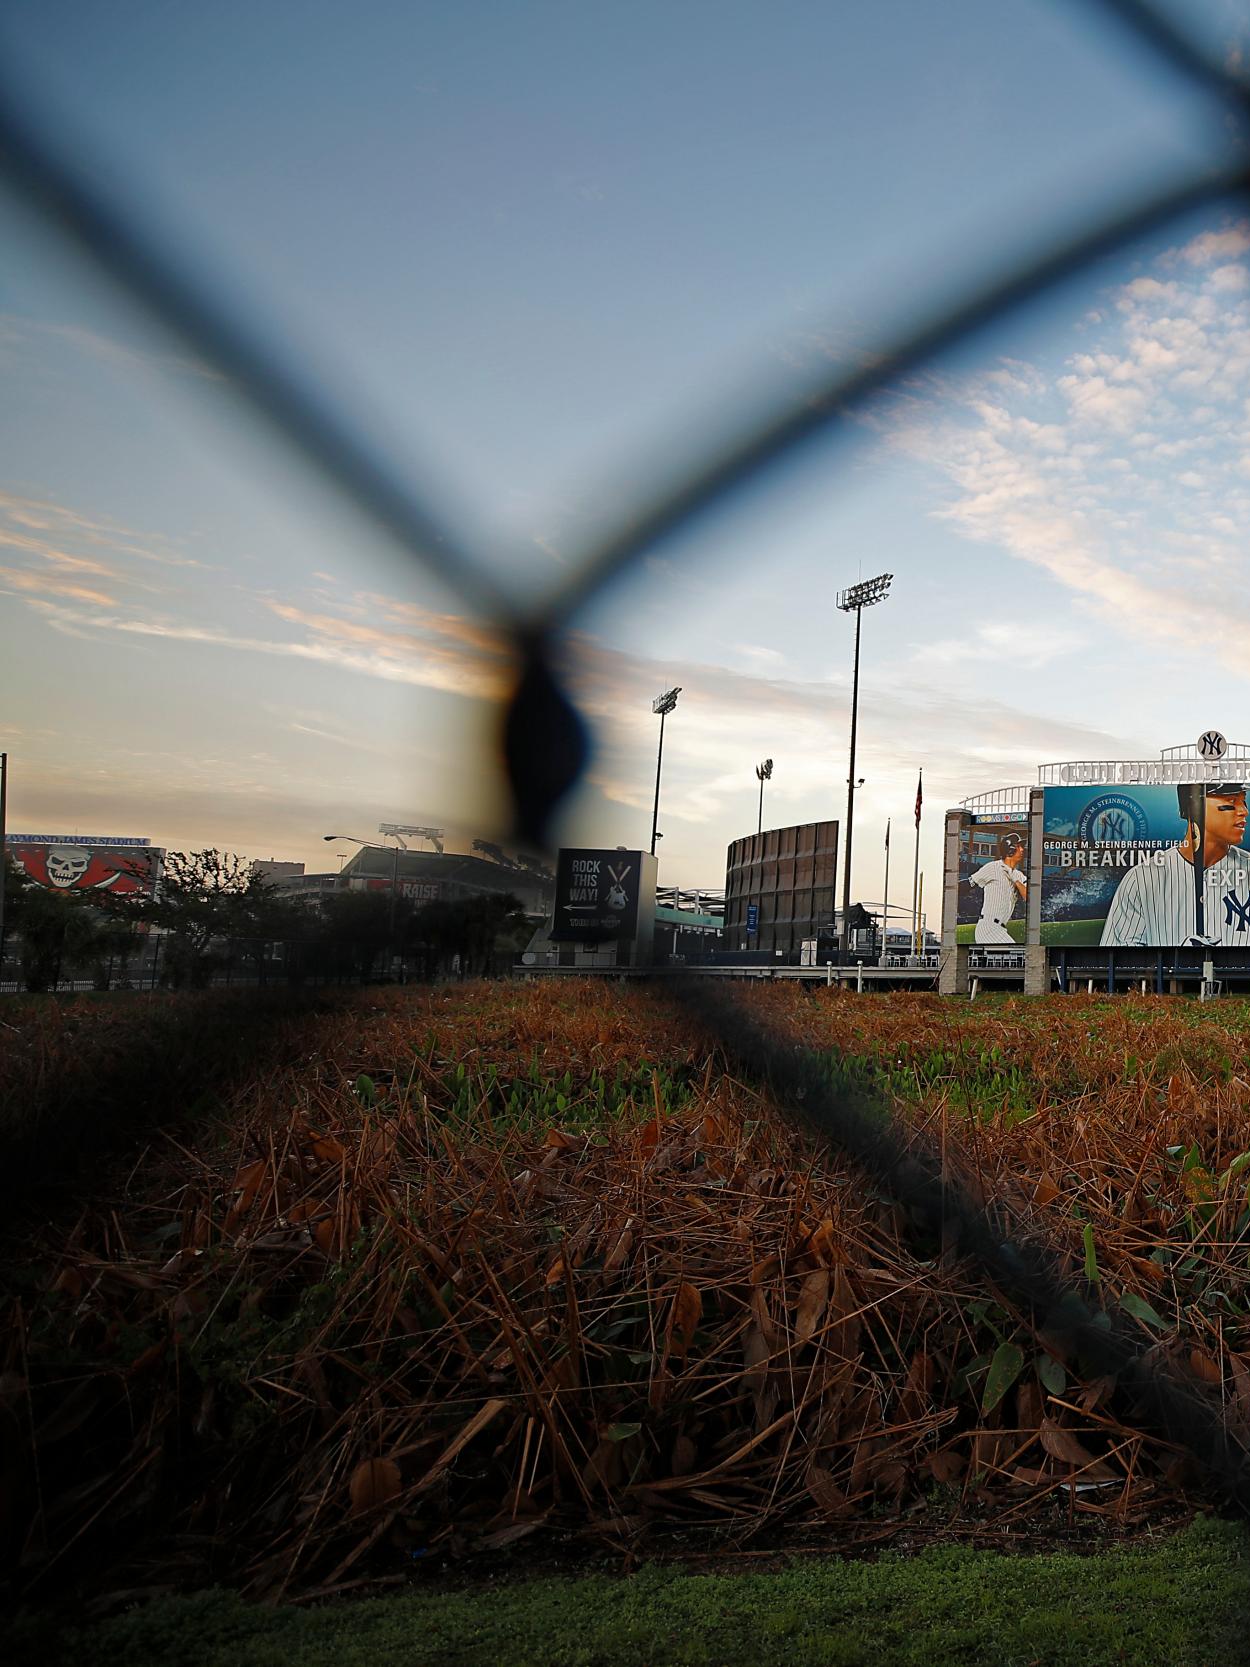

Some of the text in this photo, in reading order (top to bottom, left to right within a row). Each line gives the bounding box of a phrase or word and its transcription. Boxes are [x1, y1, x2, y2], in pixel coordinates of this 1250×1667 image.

[1201, 733, 1222, 755] NY
[976, 815, 1000, 824] ROOMS
[1011, 813, 1022, 822] GO
[6, 835, 146, 846] AYMOND JAMES STADIUM
[1043, 839, 1190, 850] GEORGE M. STEINBRENNER FIELD
[1061, 850, 1166, 867] BREAKING
[572, 860, 601, 874] ROCK
[573, 874, 598, 887] THIS
[402, 883, 439, 898] RAISE
[570, 888, 598, 901] WAY!
